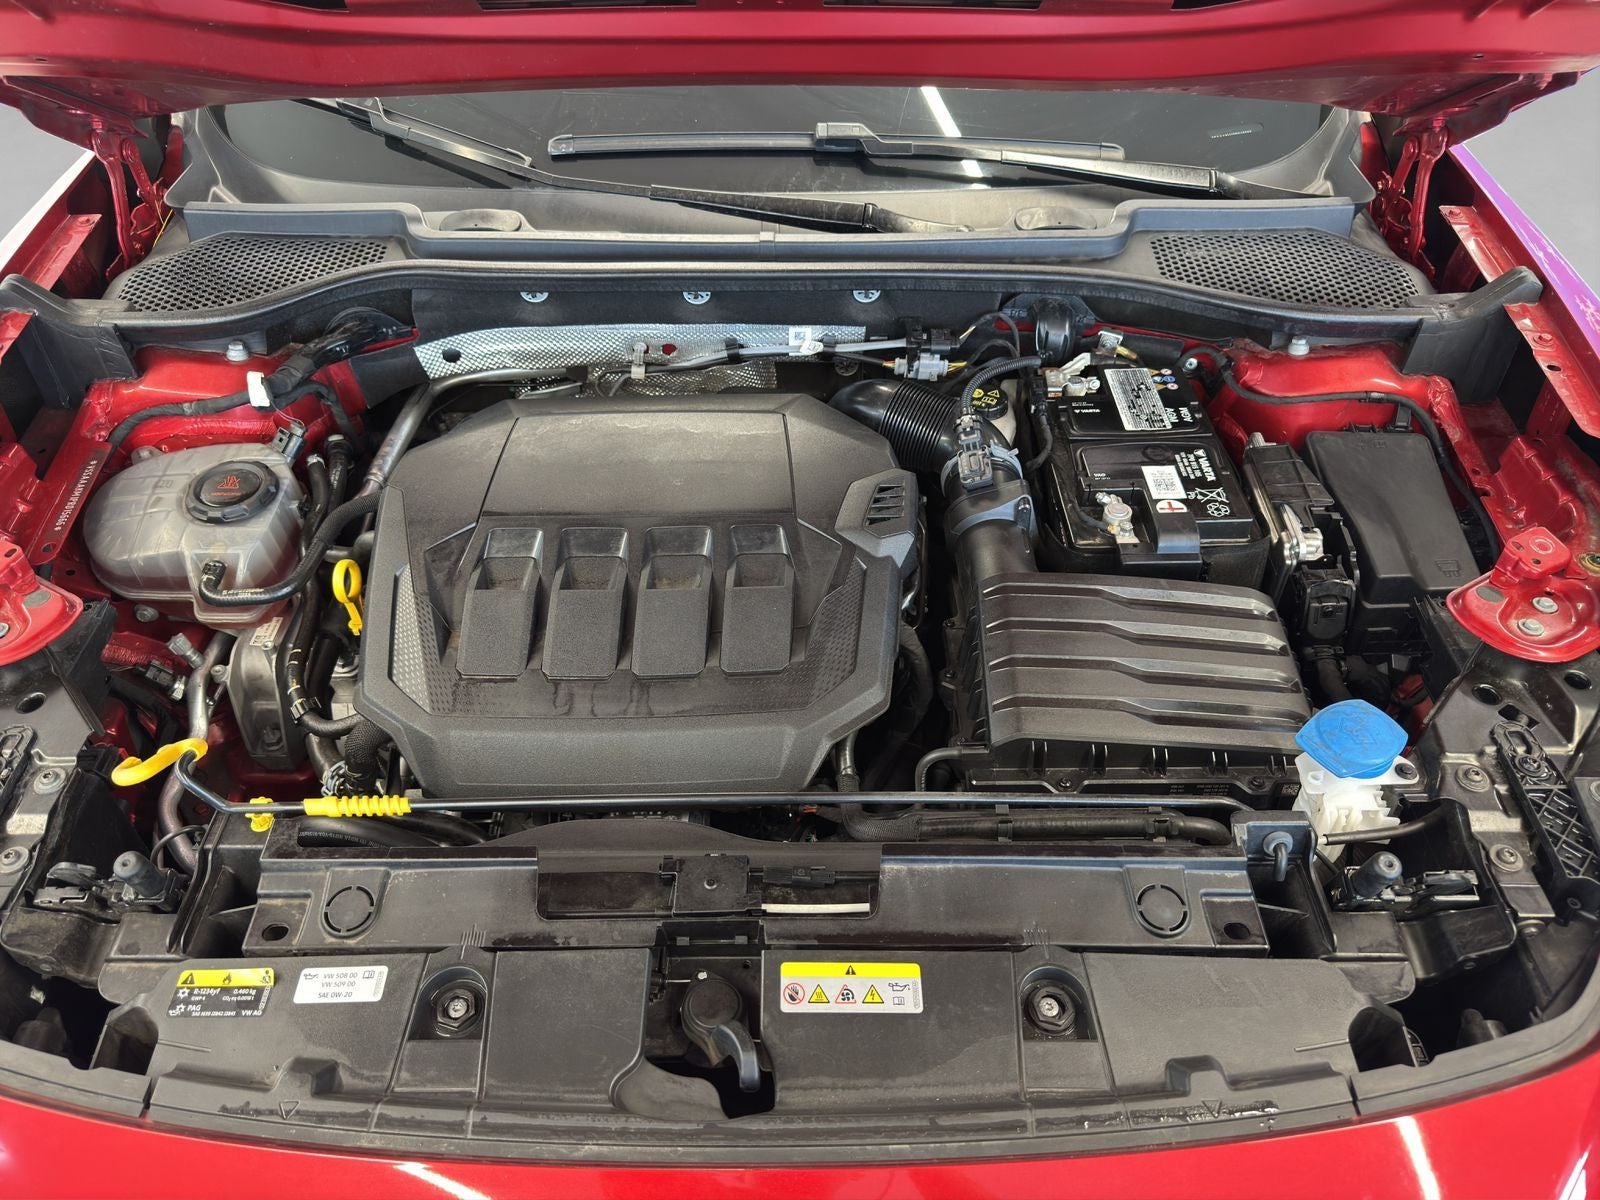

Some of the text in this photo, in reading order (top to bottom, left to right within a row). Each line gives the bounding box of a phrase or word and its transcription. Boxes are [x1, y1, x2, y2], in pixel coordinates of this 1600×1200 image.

[1164, 408, 1178, 423] AGM
[1178, 408, 1194, 423] AGM
[1199, 458, 1216, 482] VARTA
